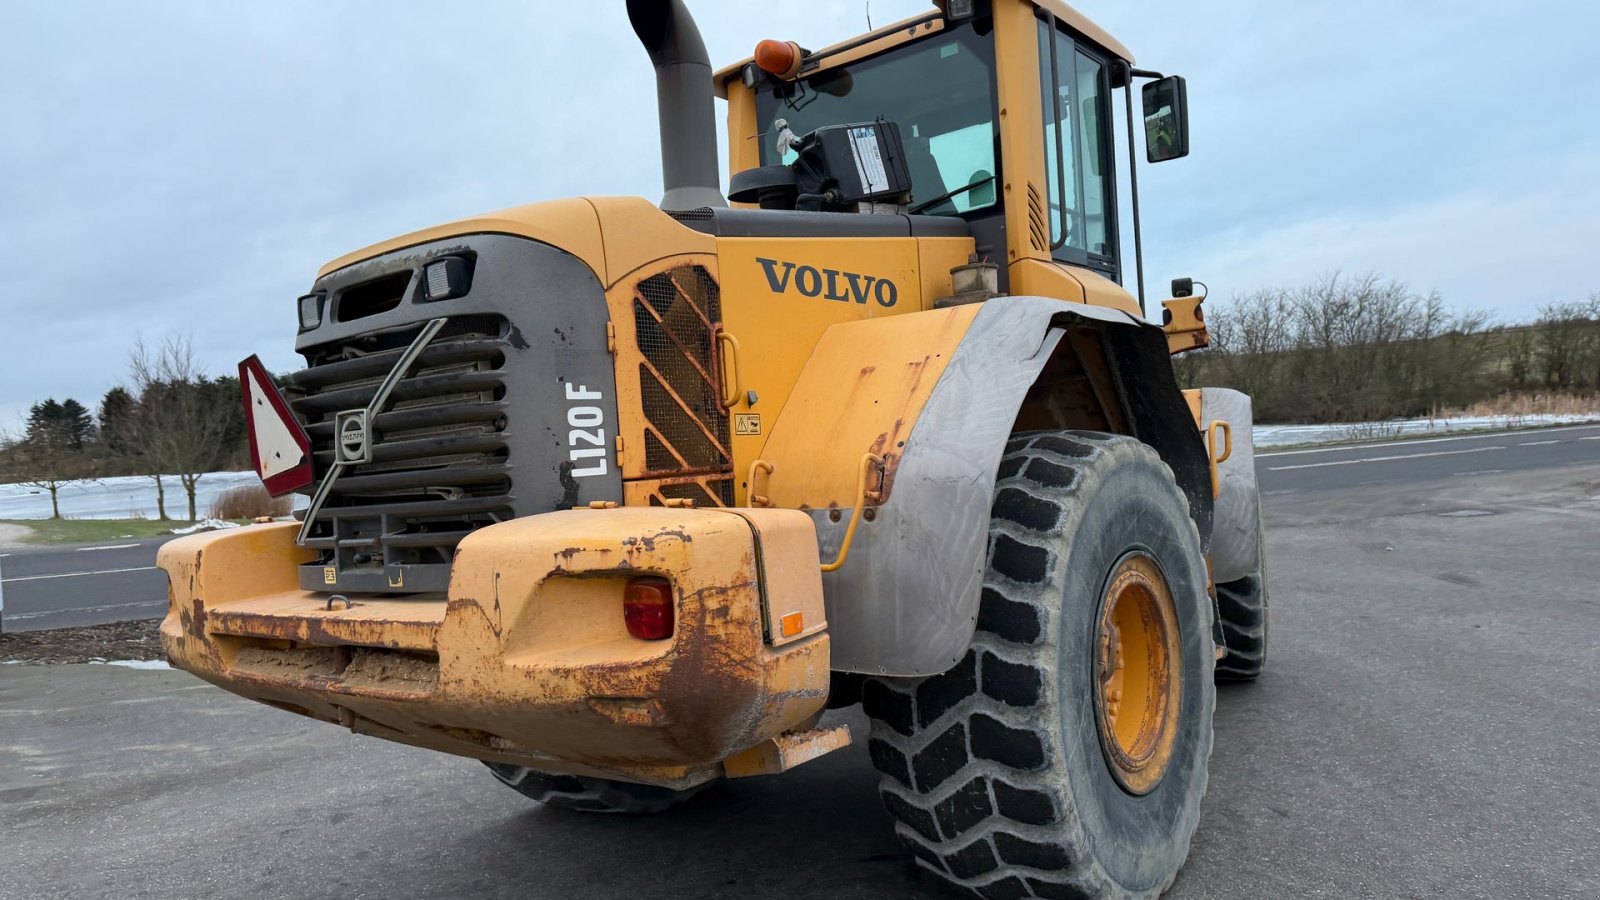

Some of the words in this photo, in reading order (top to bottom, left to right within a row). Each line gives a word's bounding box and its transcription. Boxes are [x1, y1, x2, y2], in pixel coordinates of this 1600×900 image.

[755, 256, 898, 308] VOLVO
[565, 382, 603, 400] F
[341, 432, 364, 440] VOLVO
[567, 406, 608, 478] L120
